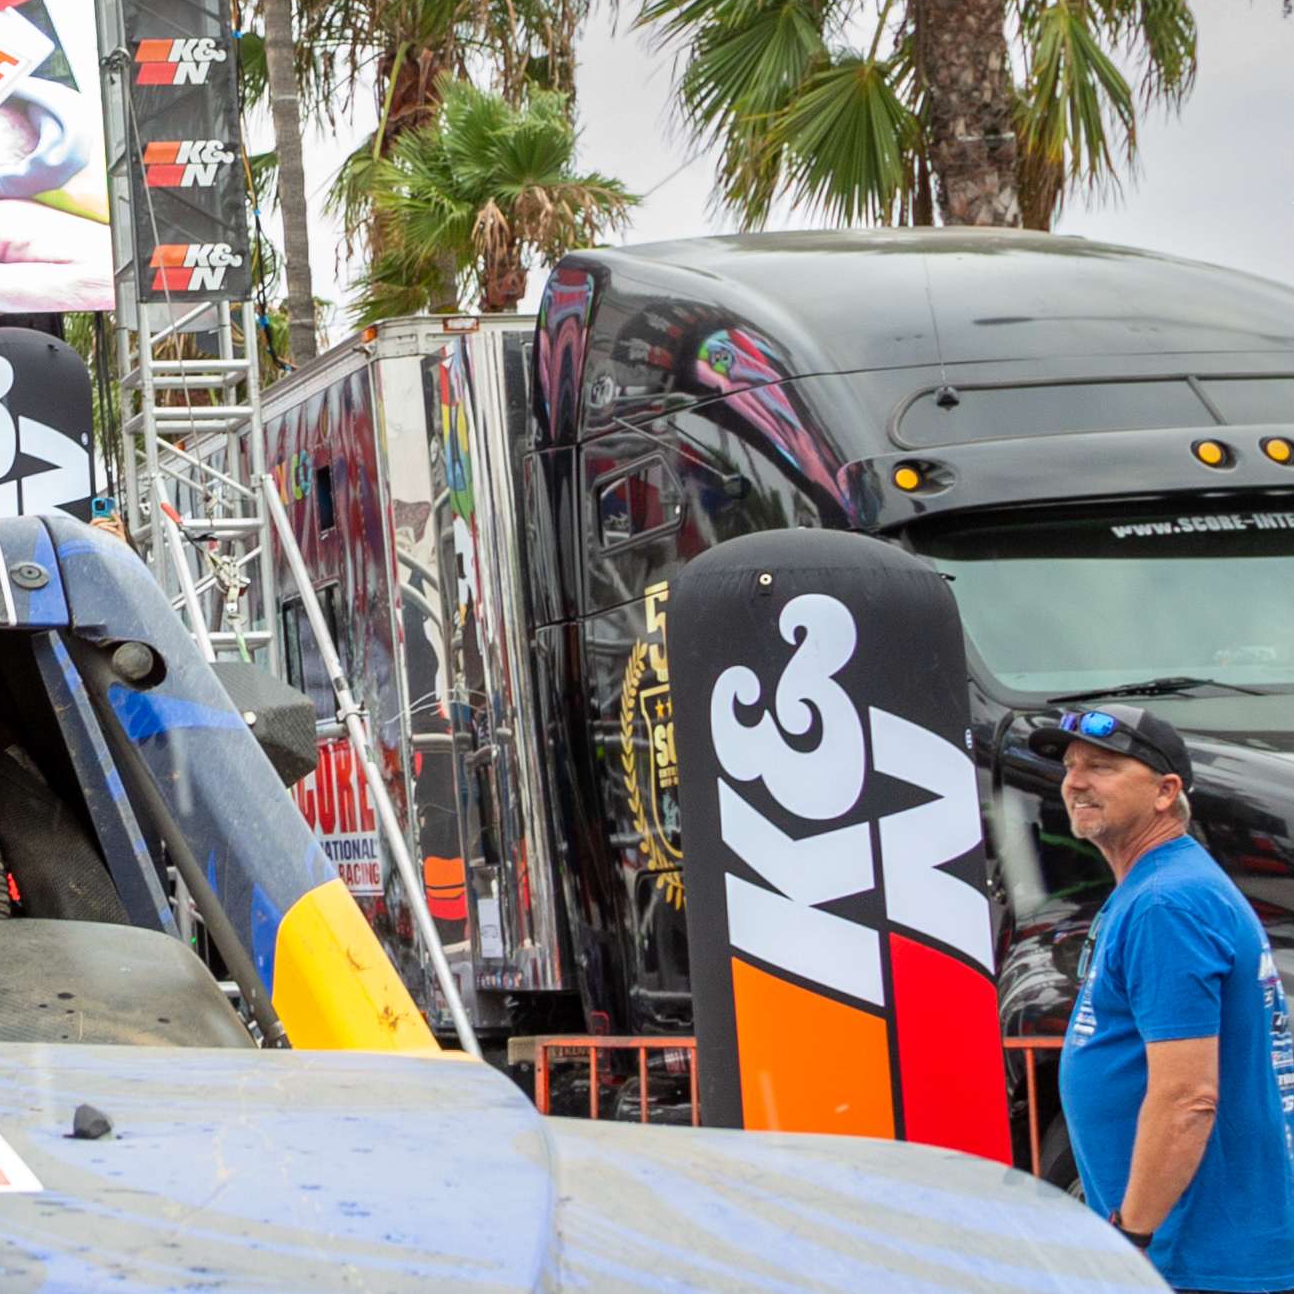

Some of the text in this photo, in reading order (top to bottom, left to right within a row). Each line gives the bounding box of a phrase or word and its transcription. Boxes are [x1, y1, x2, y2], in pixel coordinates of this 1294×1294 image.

[292, 738, 377, 835] CORE
[319, 837, 378, 862] ATIONAL
[338, 862, 381, 886] RACING
